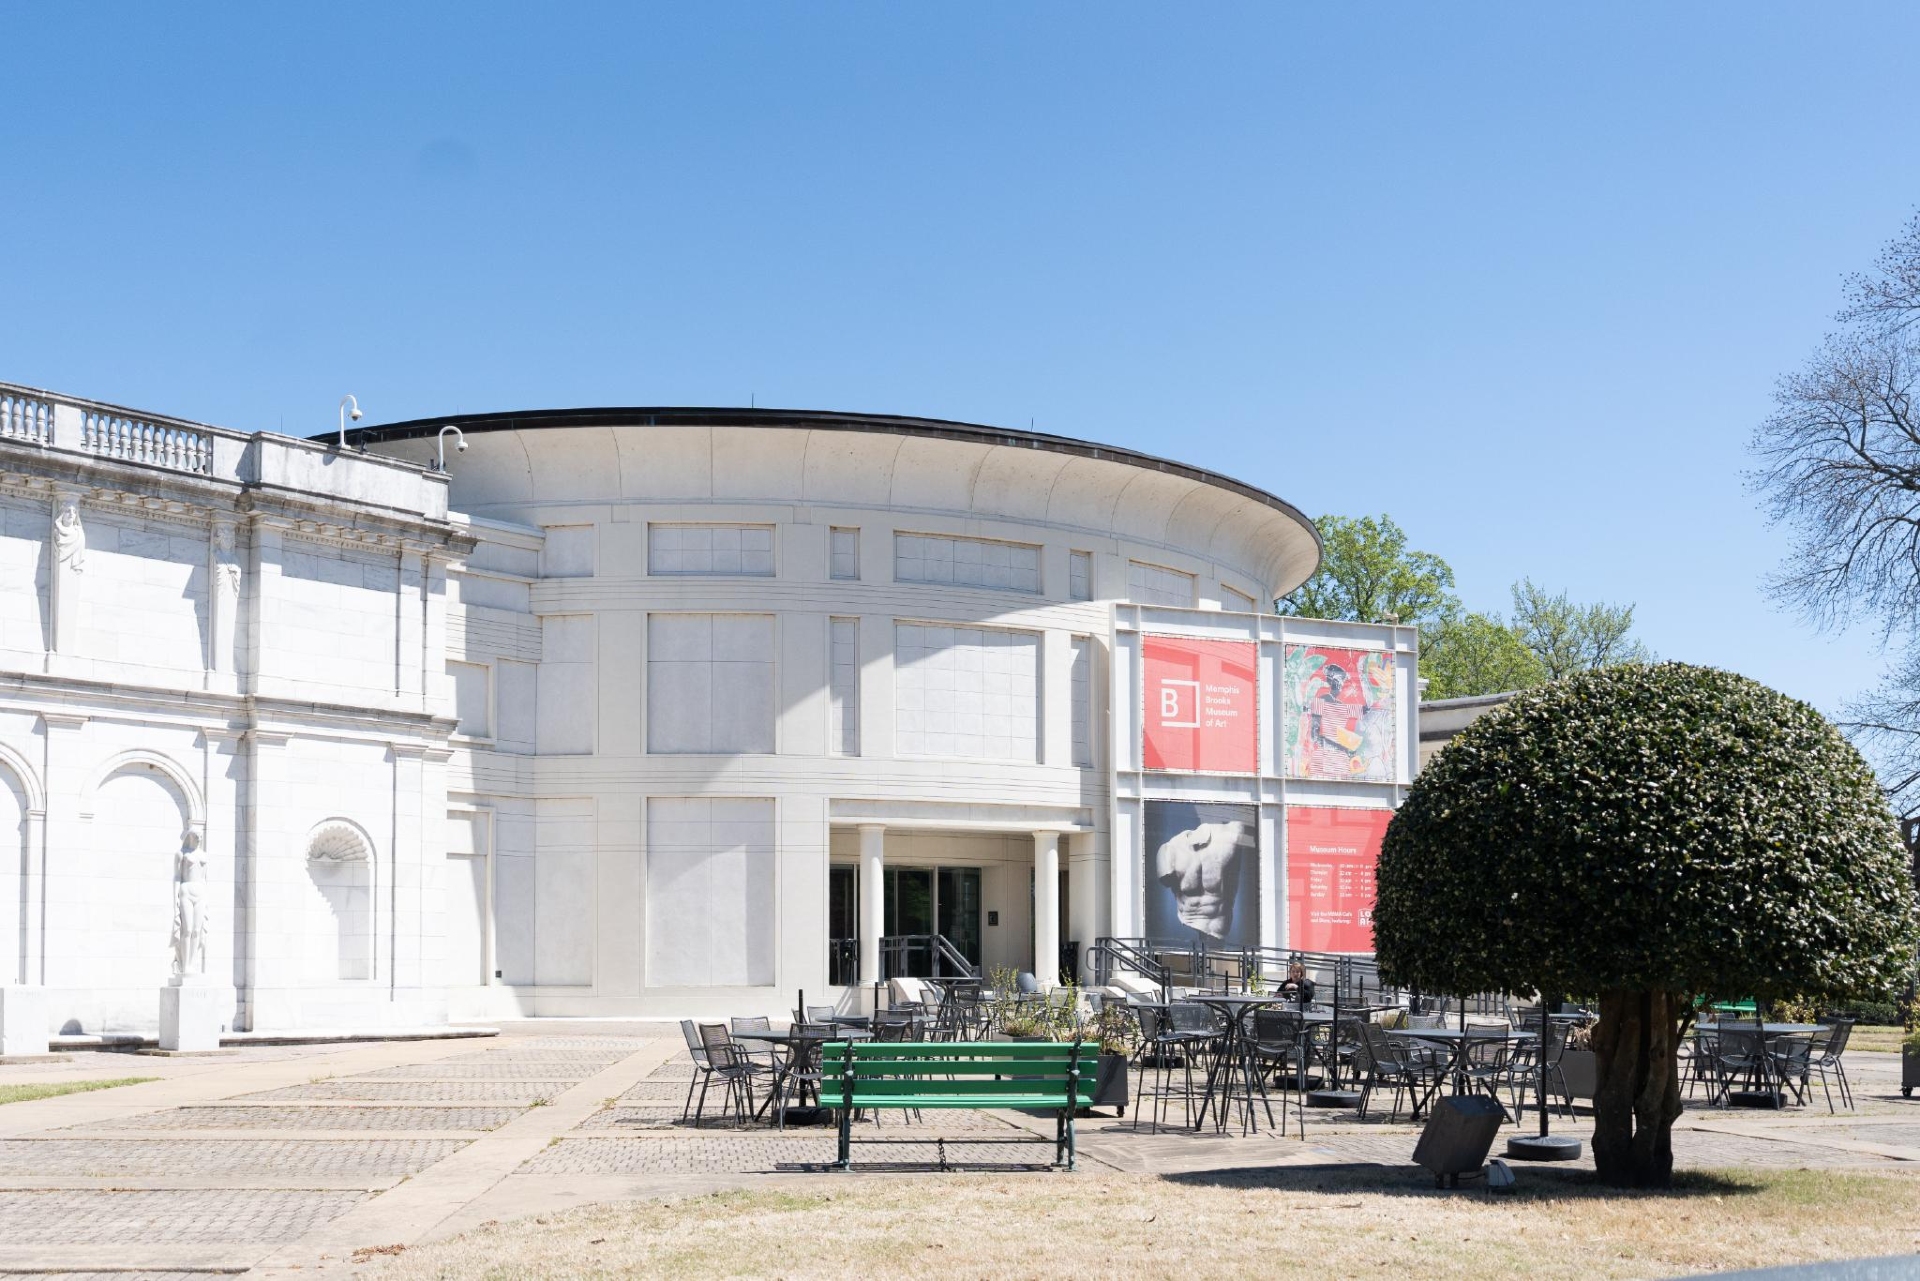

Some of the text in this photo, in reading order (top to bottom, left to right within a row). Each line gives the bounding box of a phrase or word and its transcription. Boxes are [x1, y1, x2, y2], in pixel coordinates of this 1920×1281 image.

[1205, 684, 1240, 695] Memphis
[1161, 688, 1179, 718] B
[1205, 696, 1231, 705] Brooks
[1205, 707, 1238, 717] Museum
[1205, 719, 1227, 728] of Art
[1309, 845, 1337, 854] Museum
